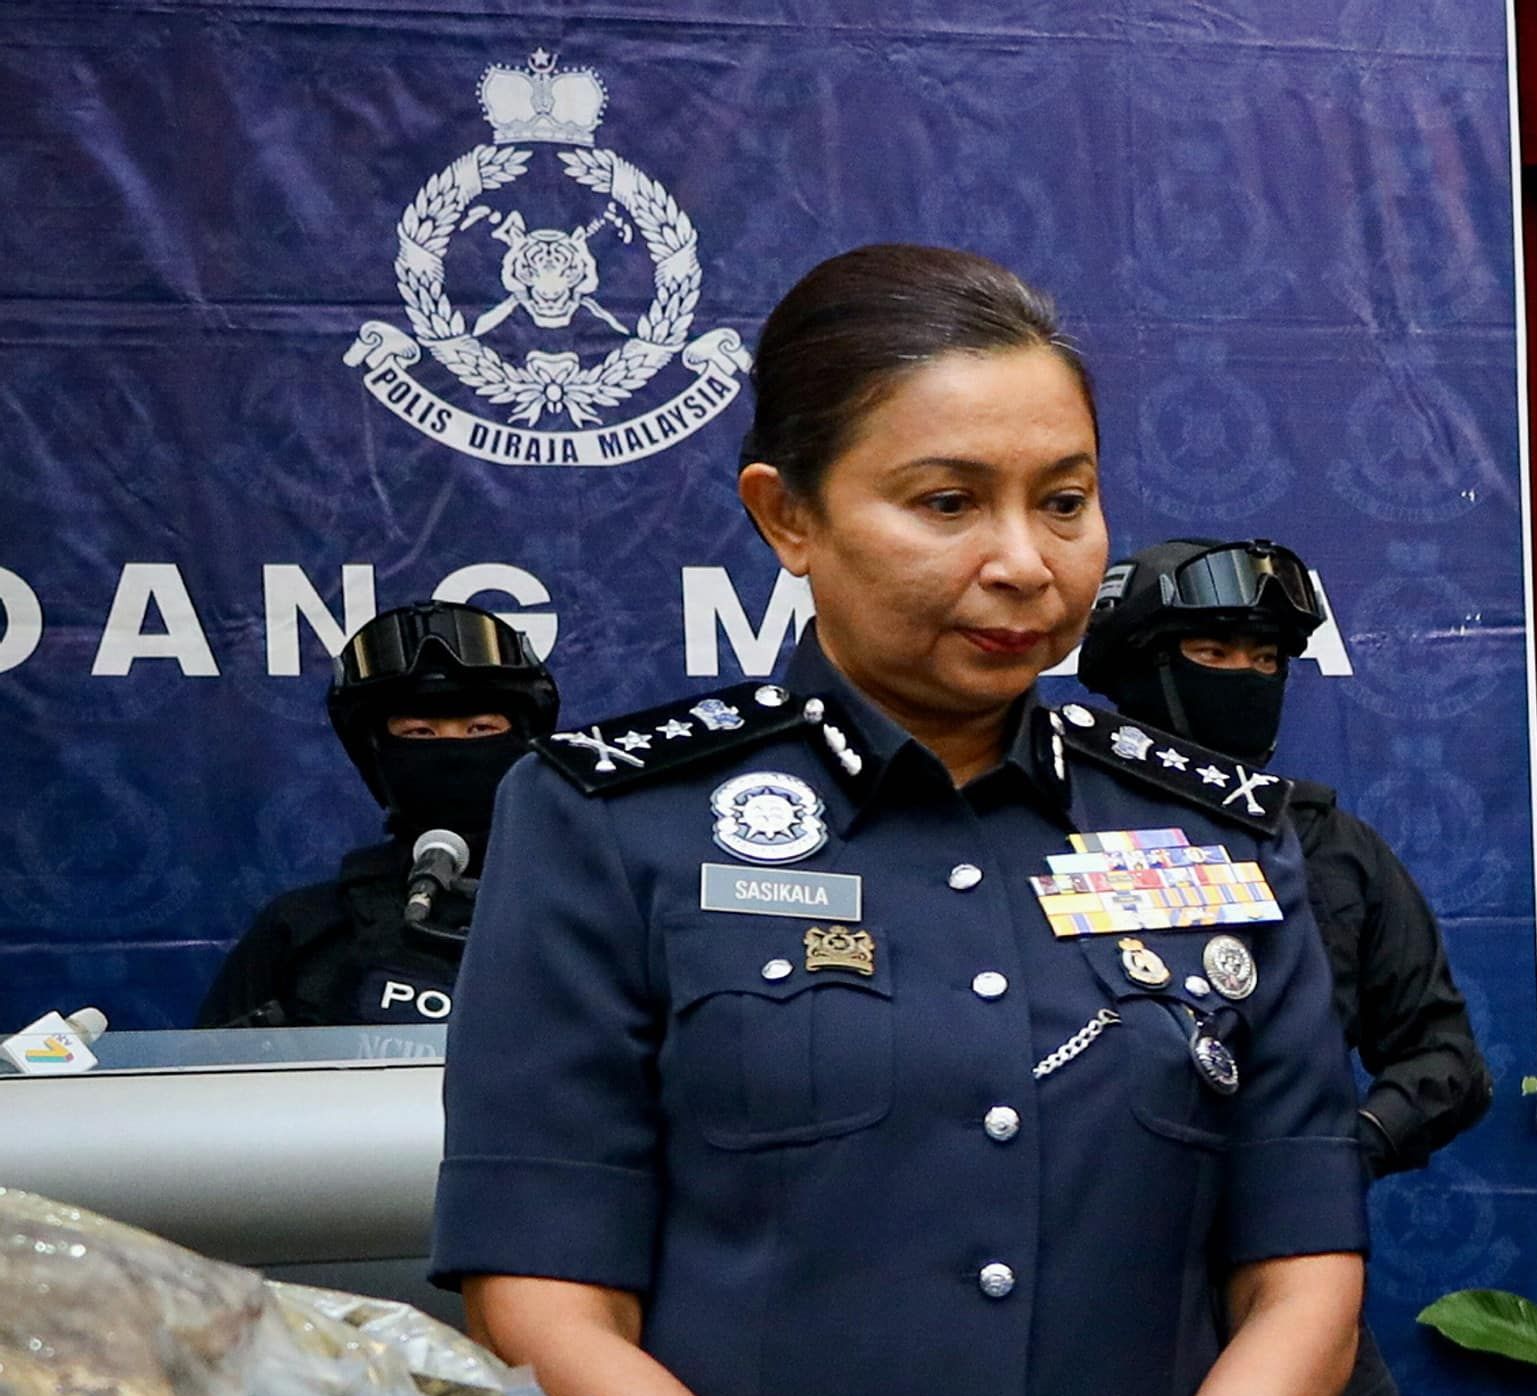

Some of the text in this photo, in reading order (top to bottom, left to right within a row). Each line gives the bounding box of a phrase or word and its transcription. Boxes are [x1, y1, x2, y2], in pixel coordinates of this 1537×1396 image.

[372, 368, 733, 464] POLIS DIRAJA MALAYSIA
[734, 879, 829, 907] SASIKALA
[381, 980, 453, 1019] PO
